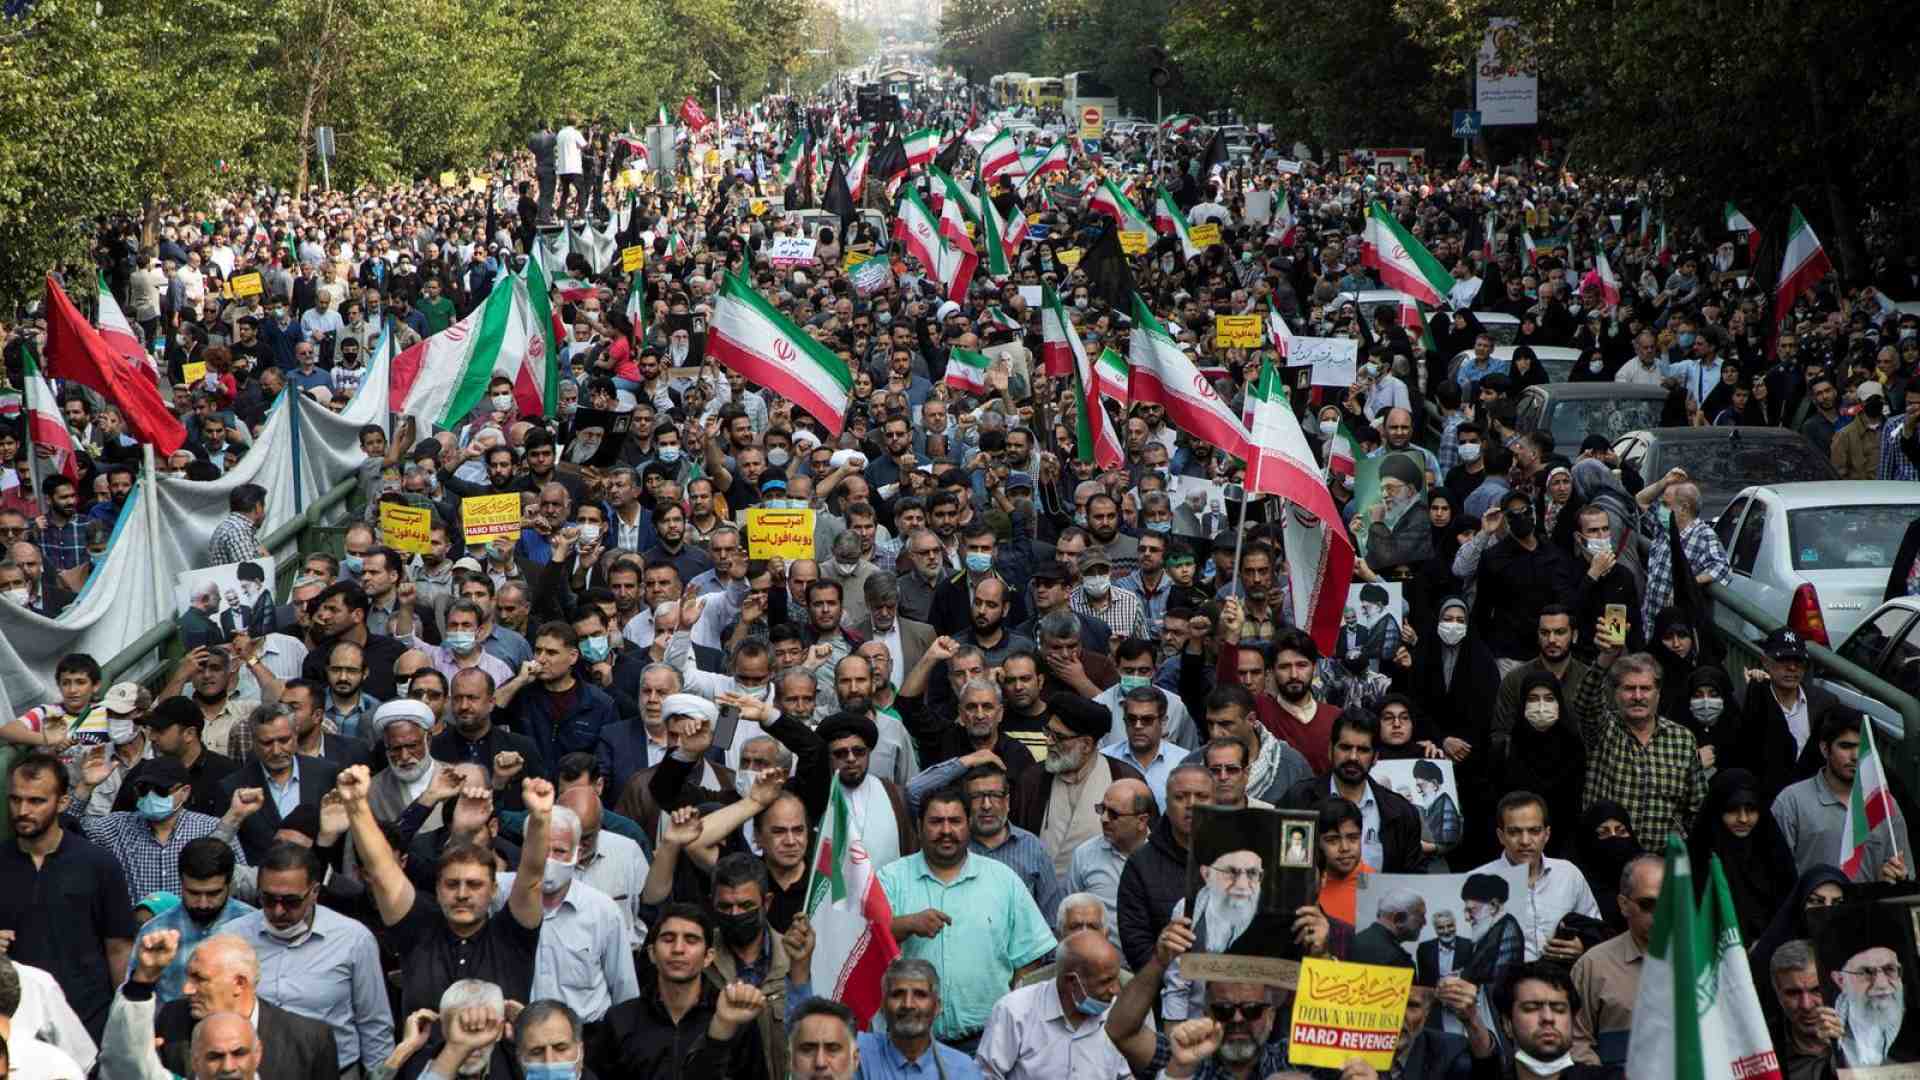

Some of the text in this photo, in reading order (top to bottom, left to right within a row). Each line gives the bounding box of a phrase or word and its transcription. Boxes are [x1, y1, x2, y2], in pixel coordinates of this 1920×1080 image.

[465, 526, 489, 537] HARD
[1299, 1005, 1340, 1024] DOWN
[1345, 1010, 1376, 1028] WITH
[1294, 1025, 1398, 1051] HARD REVENGE
